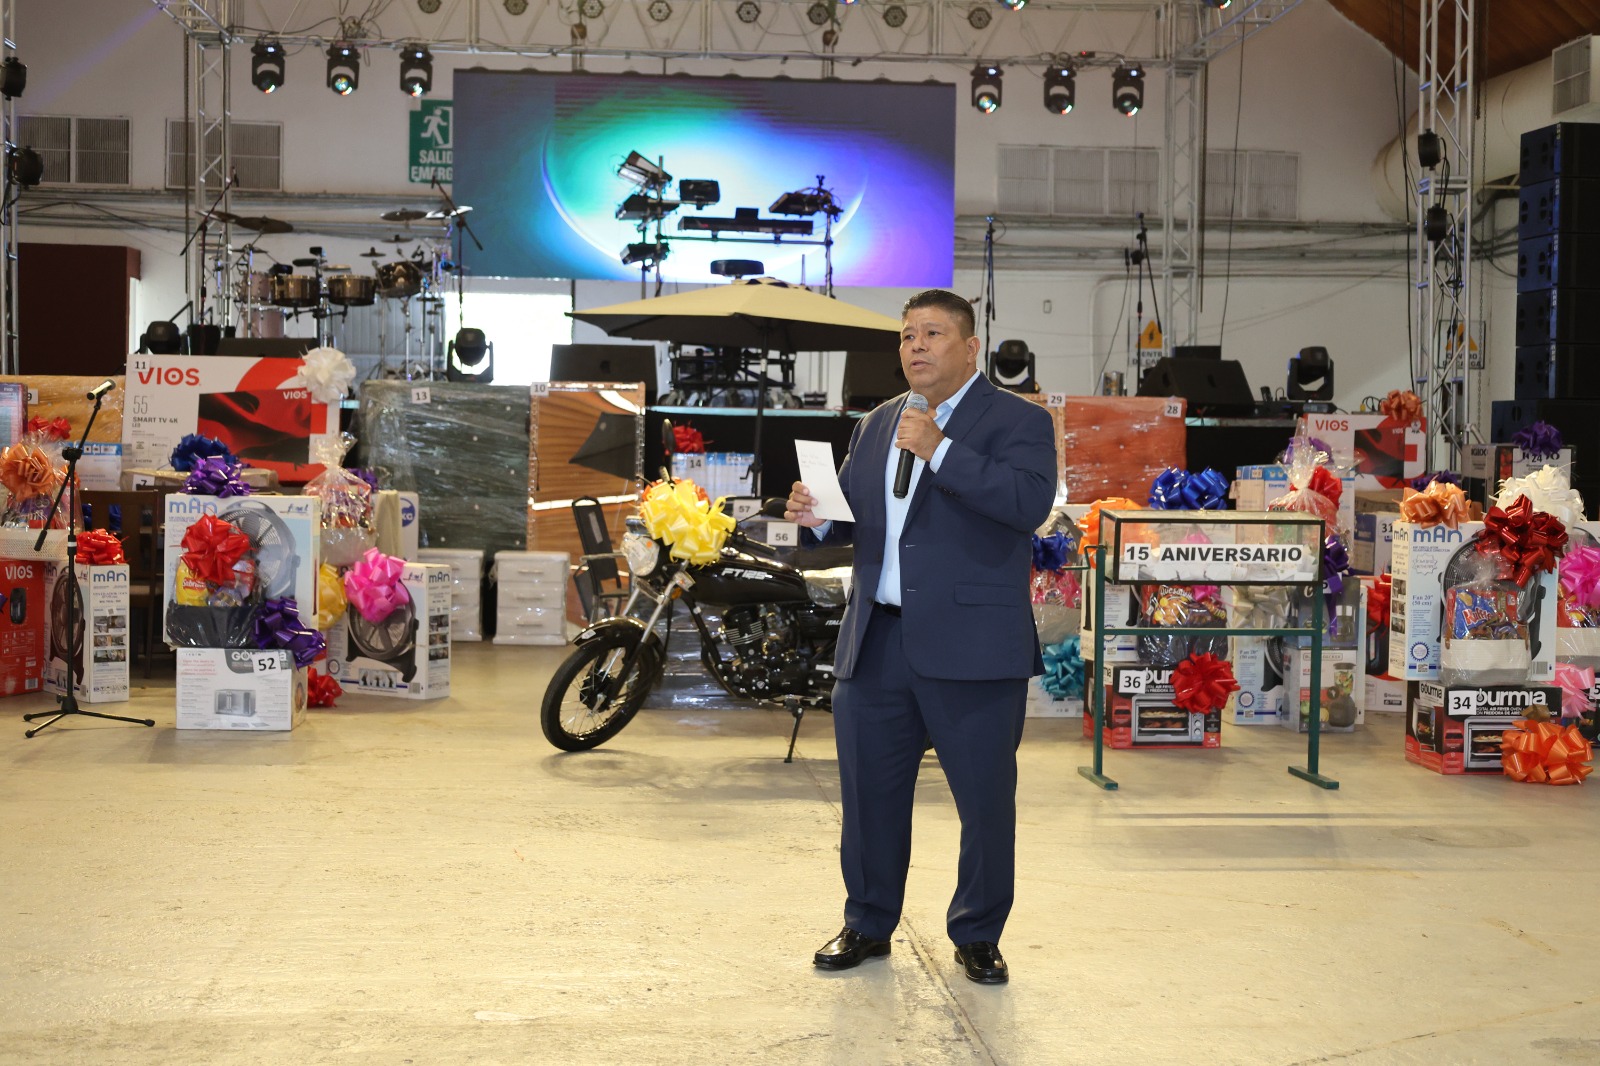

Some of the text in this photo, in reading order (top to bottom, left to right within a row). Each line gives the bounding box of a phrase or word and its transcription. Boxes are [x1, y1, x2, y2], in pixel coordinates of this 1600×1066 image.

[419, 150, 453, 164] SALID
[411, 166, 453, 180] EMERG
[135, 361, 146, 370] 11
[138, 367, 200, 386] VIOS
[534, 384, 546, 393] 10
[282, 390, 308, 400] VIOS
[415, 391, 427, 401] 13
[1050, 395, 1062, 404] 29
[133, 395, 148, 415] 55
[1166, 405, 1178, 414] 28
[1315, 420, 1348, 431] VIOS
[690, 459, 702, 468] 14
[1531, 454, 1543, 463] 24
[738, 505, 751, 513] 57
[1381, 523, 1393, 533] 31
[775, 533, 788, 541] 56
[1126, 546, 1302, 562] 15 ANIVERSARIO
[5, 565, 34, 580] VIOS
[258, 657, 276, 671] 52
[1123, 676, 1141, 688] 36
[1476, 688, 1547, 706] ourmia
[1453, 696, 1471, 710] 34
